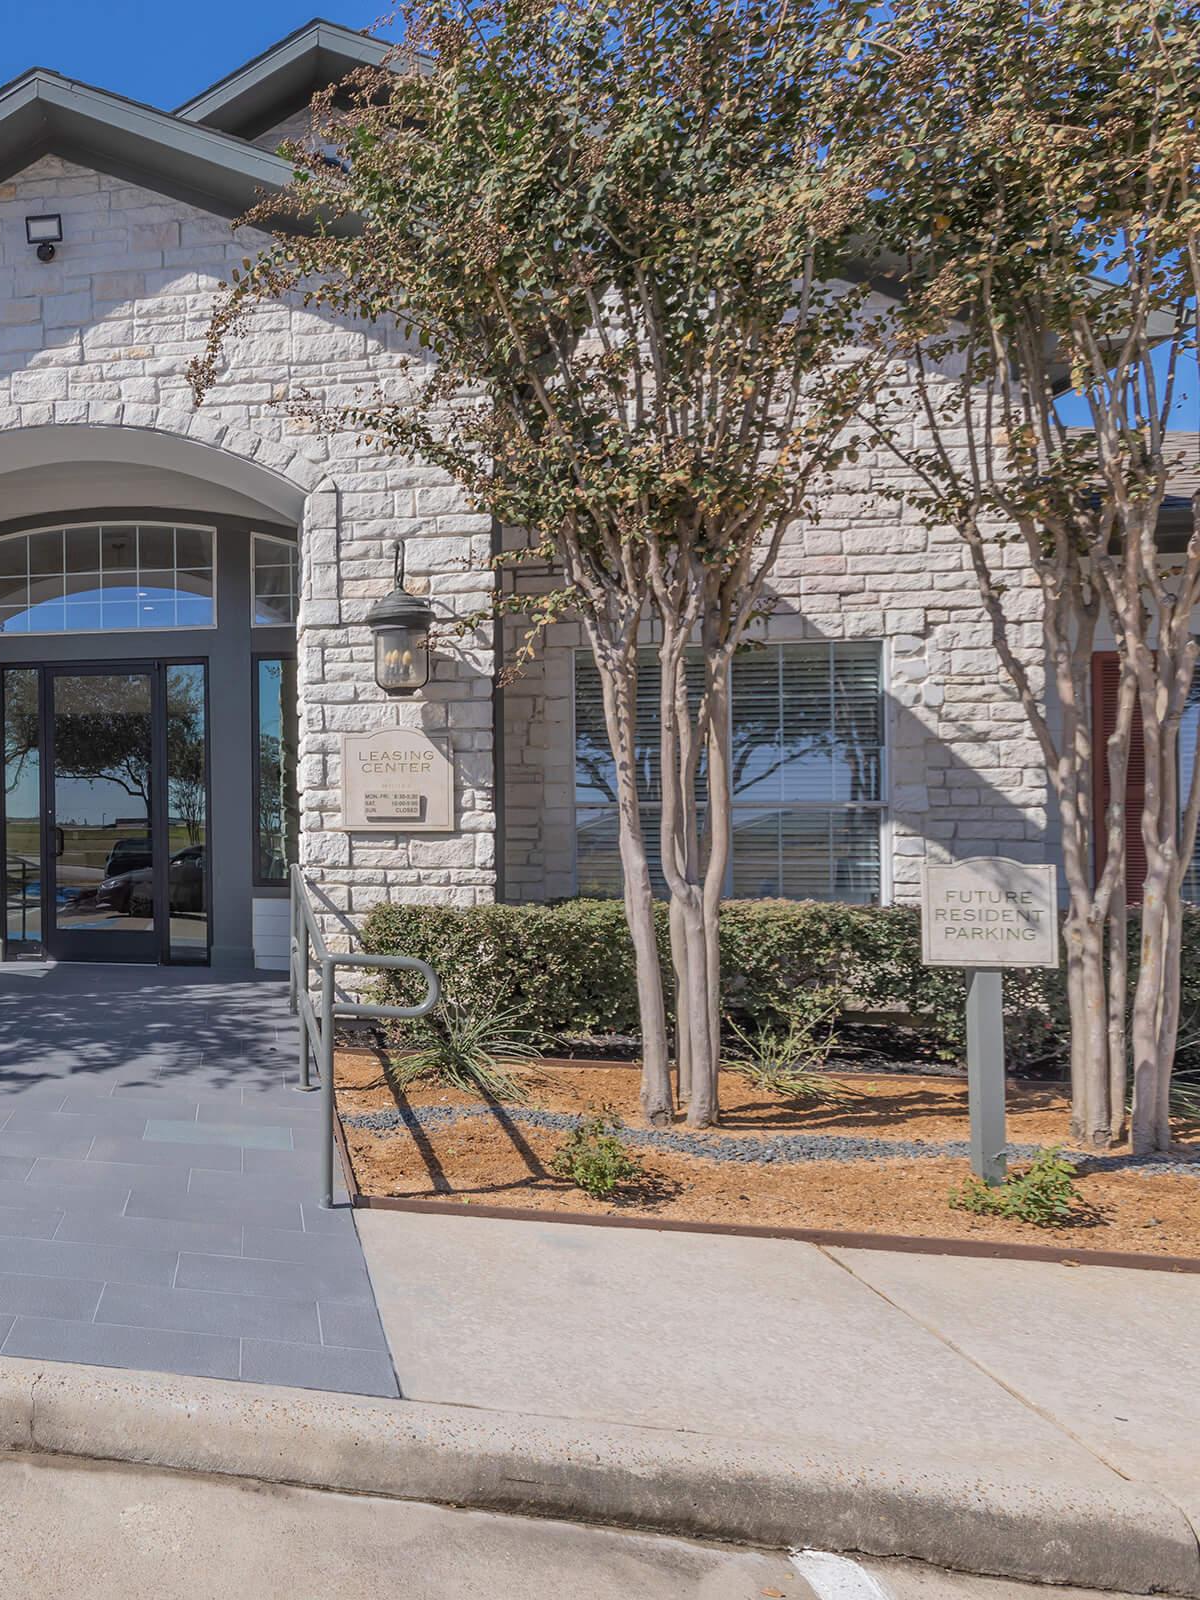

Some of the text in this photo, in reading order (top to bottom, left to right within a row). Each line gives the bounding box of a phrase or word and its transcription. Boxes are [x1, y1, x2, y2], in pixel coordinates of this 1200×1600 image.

[358, 750, 435, 761] LEASING
[361, 762, 432, 773] CENTER
[945, 890, 1033, 904] FUTURE
[935, 908, 1045, 923] RESIDENT
[944, 927, 1036, 941] PARKING
